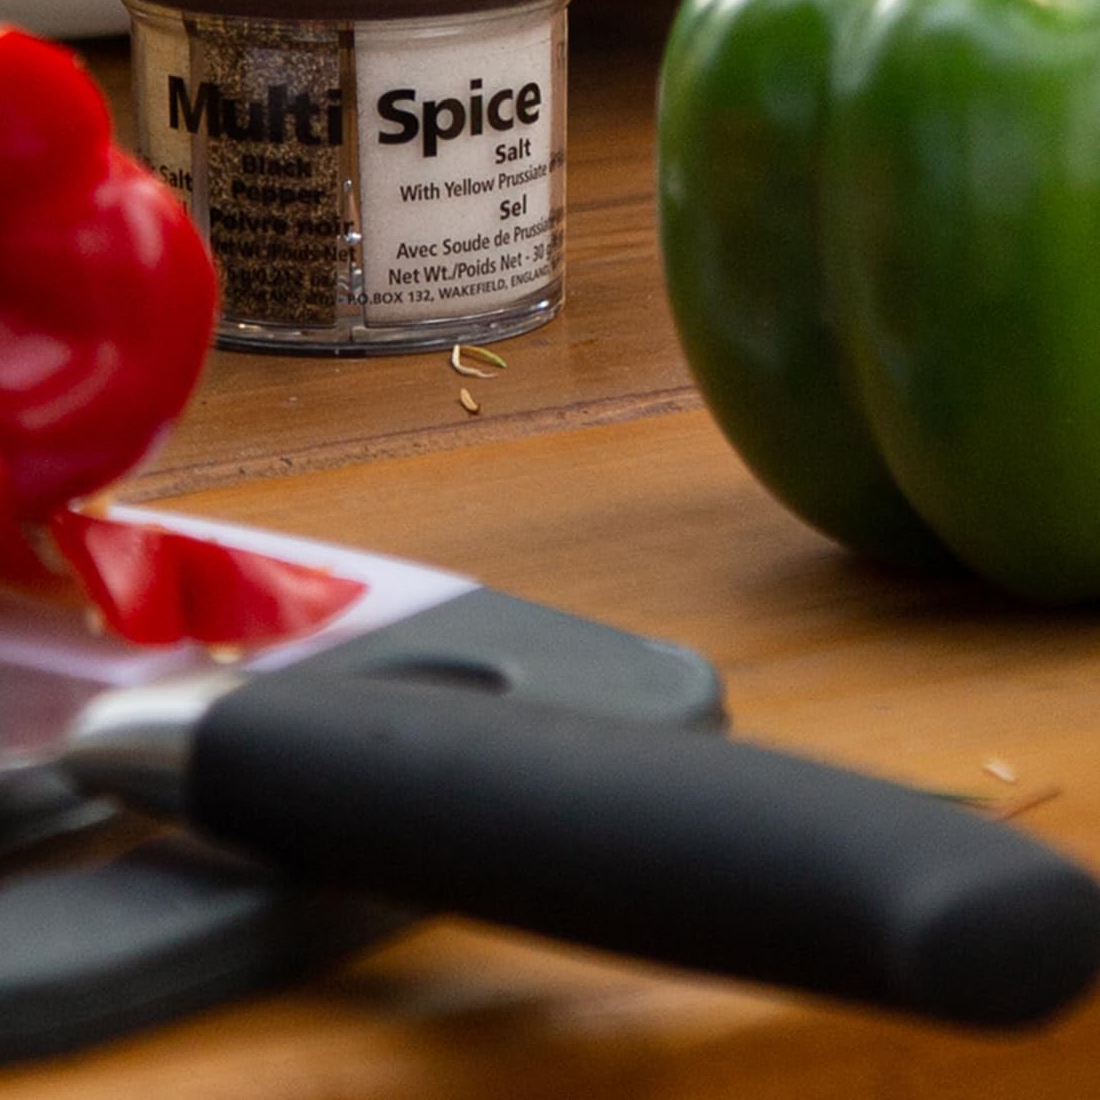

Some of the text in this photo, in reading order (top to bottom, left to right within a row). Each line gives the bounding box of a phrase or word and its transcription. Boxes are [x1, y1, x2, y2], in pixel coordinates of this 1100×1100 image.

[168, 74, 542, 158] Multi Spice
[495, 138, 532, 165] Salt
[159, 164, 193, 192] Salt
[242, 154, 312, 178] Black
[232, 179, 326, 205] Pepper
[400, 163, 548, 202] With Yellow Prussiate
[210, 206, 354, 237] Poivre noir
[499, 194, 528, 221] Sel
[396, 242, 438, 260] Avec
[443, 233, 491, 256] Soude
[494, 229, 511, 247] de
[388, 268, 420, 286] Net
[423, 257, 497, 283] Wt./Poids
[500, 252, 523, 272] Net
[409, 289, 435, 302] 132,
[439, 279, 509, 300] WAKEFIELD,
